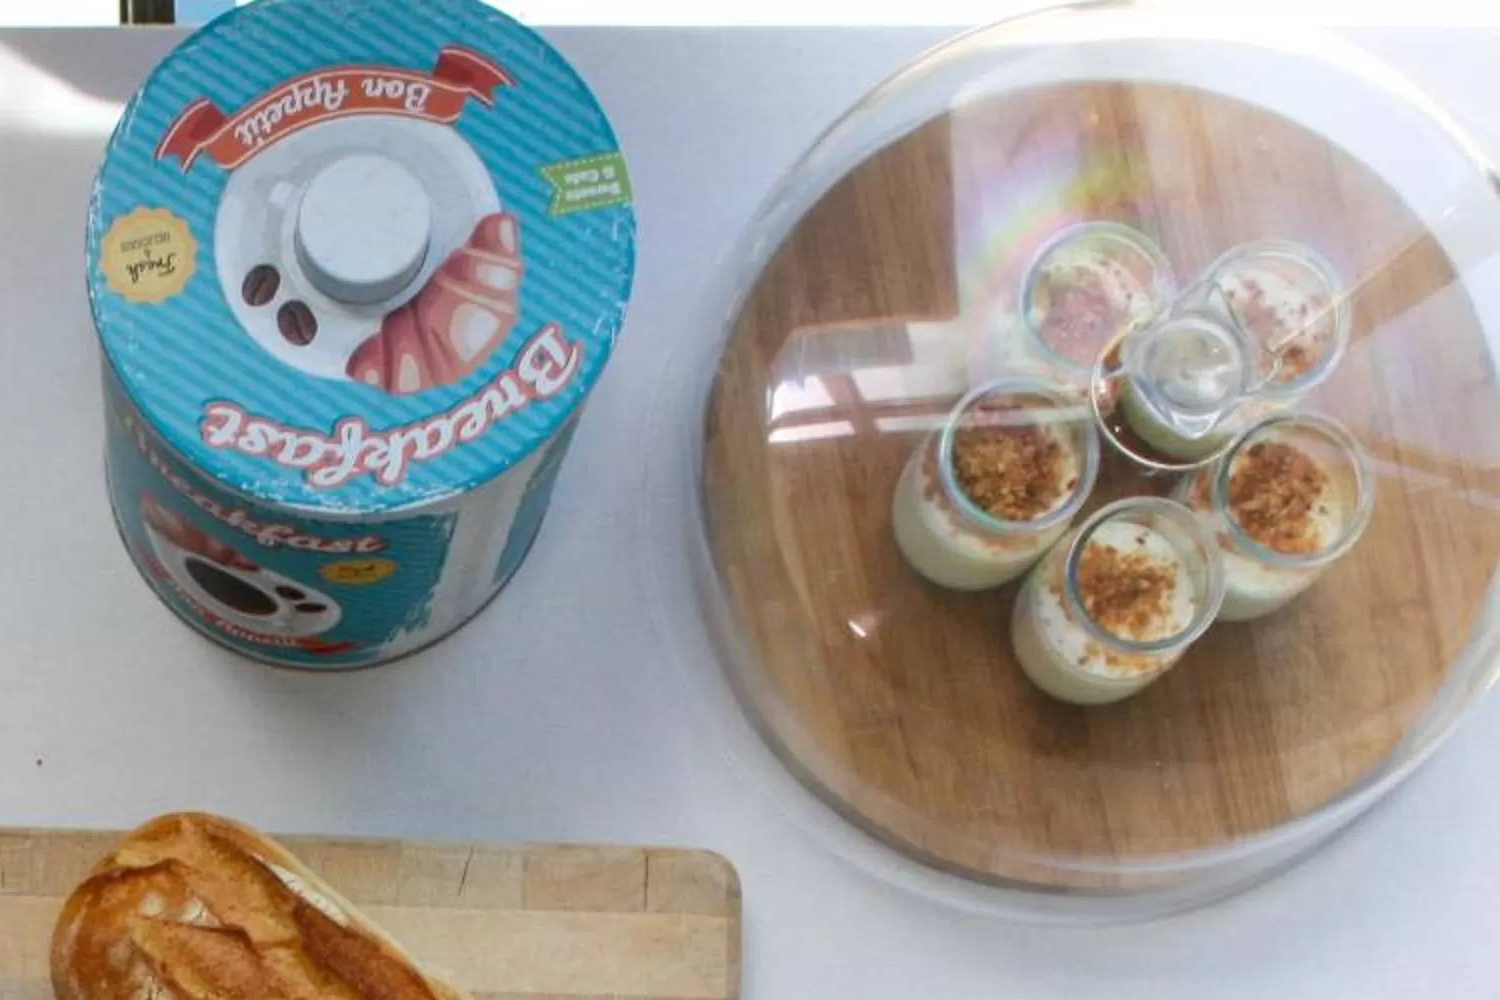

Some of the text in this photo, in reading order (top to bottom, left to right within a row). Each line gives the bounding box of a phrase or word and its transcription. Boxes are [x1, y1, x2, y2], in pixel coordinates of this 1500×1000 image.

[233, 76, 432, 145] Bon Appetit
[125, 252, 177, 285] Fresh
[202, 322, 582, 487] Breakfast
